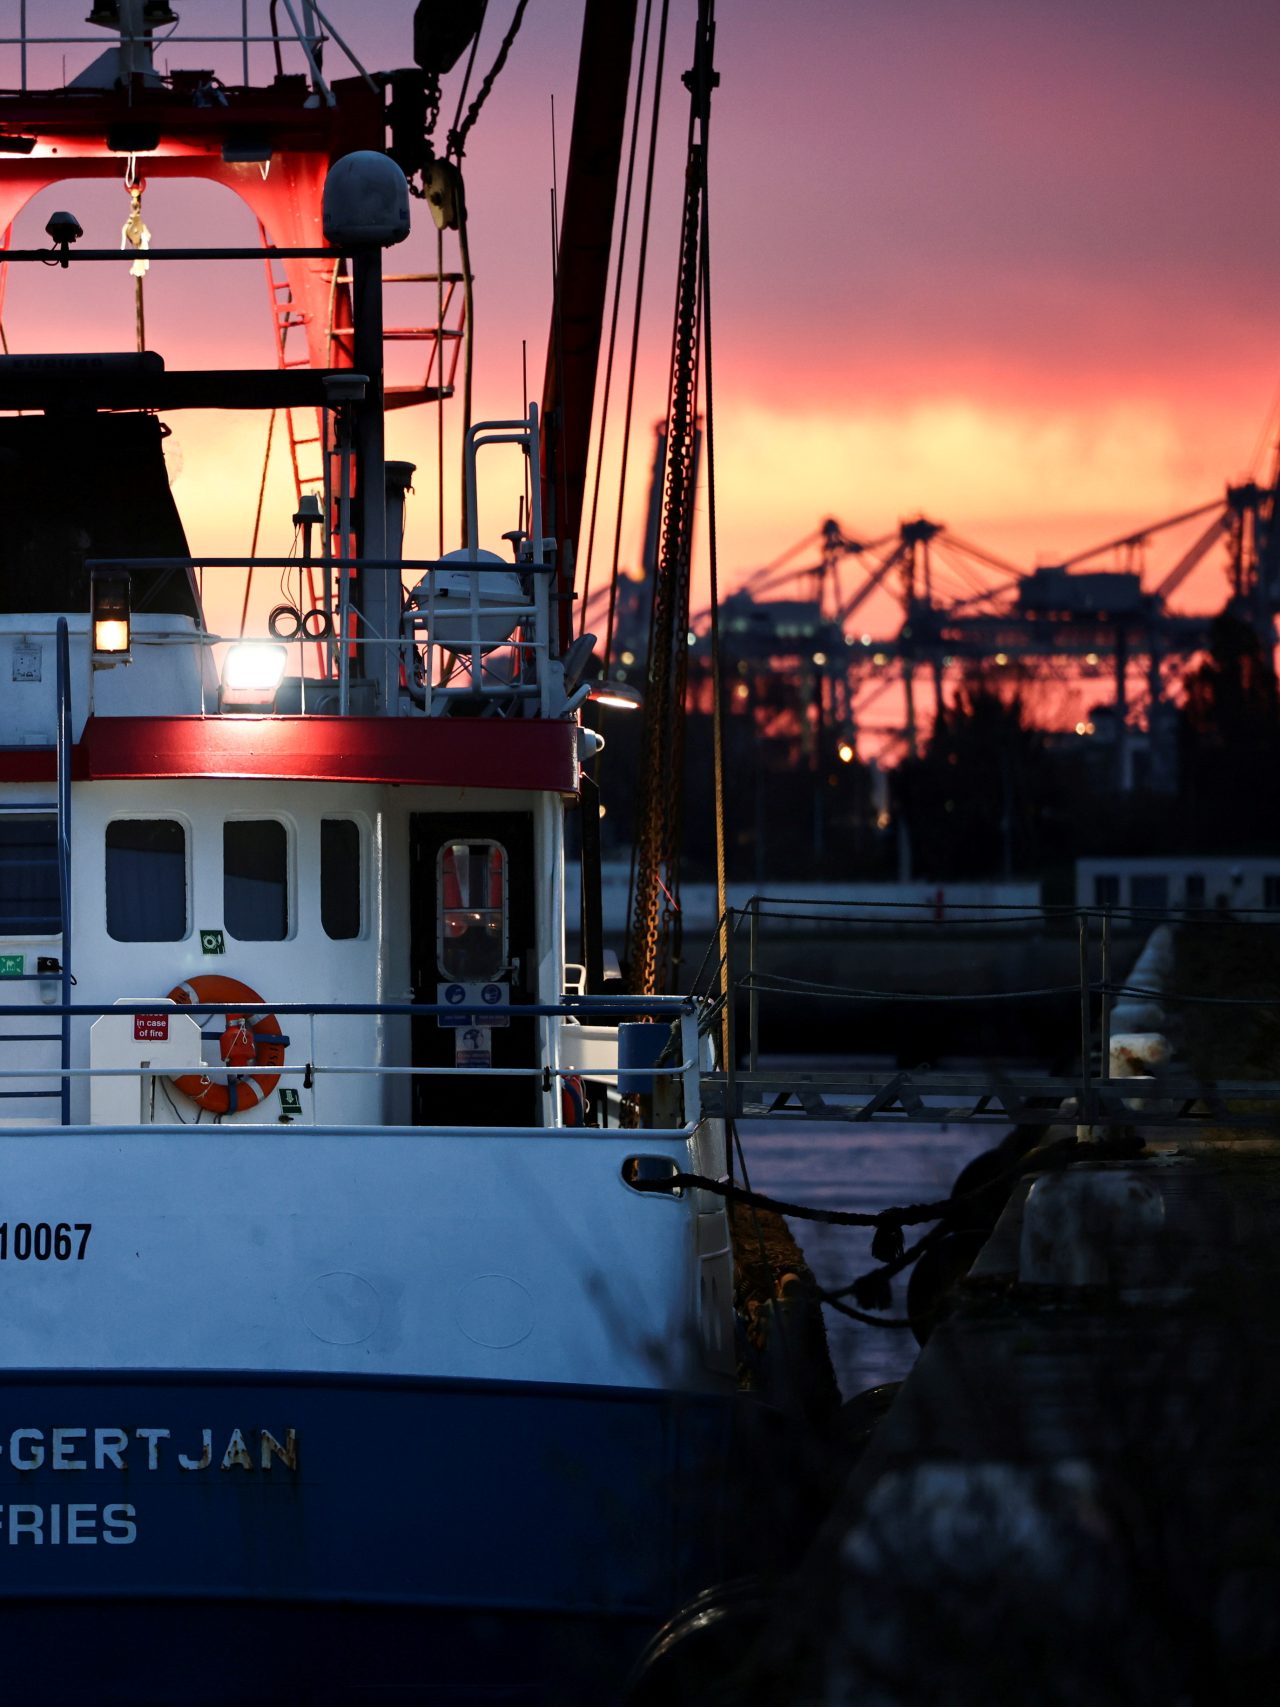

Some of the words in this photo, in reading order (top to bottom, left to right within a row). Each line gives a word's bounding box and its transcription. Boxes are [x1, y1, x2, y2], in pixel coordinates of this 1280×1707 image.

[136, 1018, 145, 1027] in
[139, 1029, 148, 1037] of
[149, 1029, 164, 1037] fire
